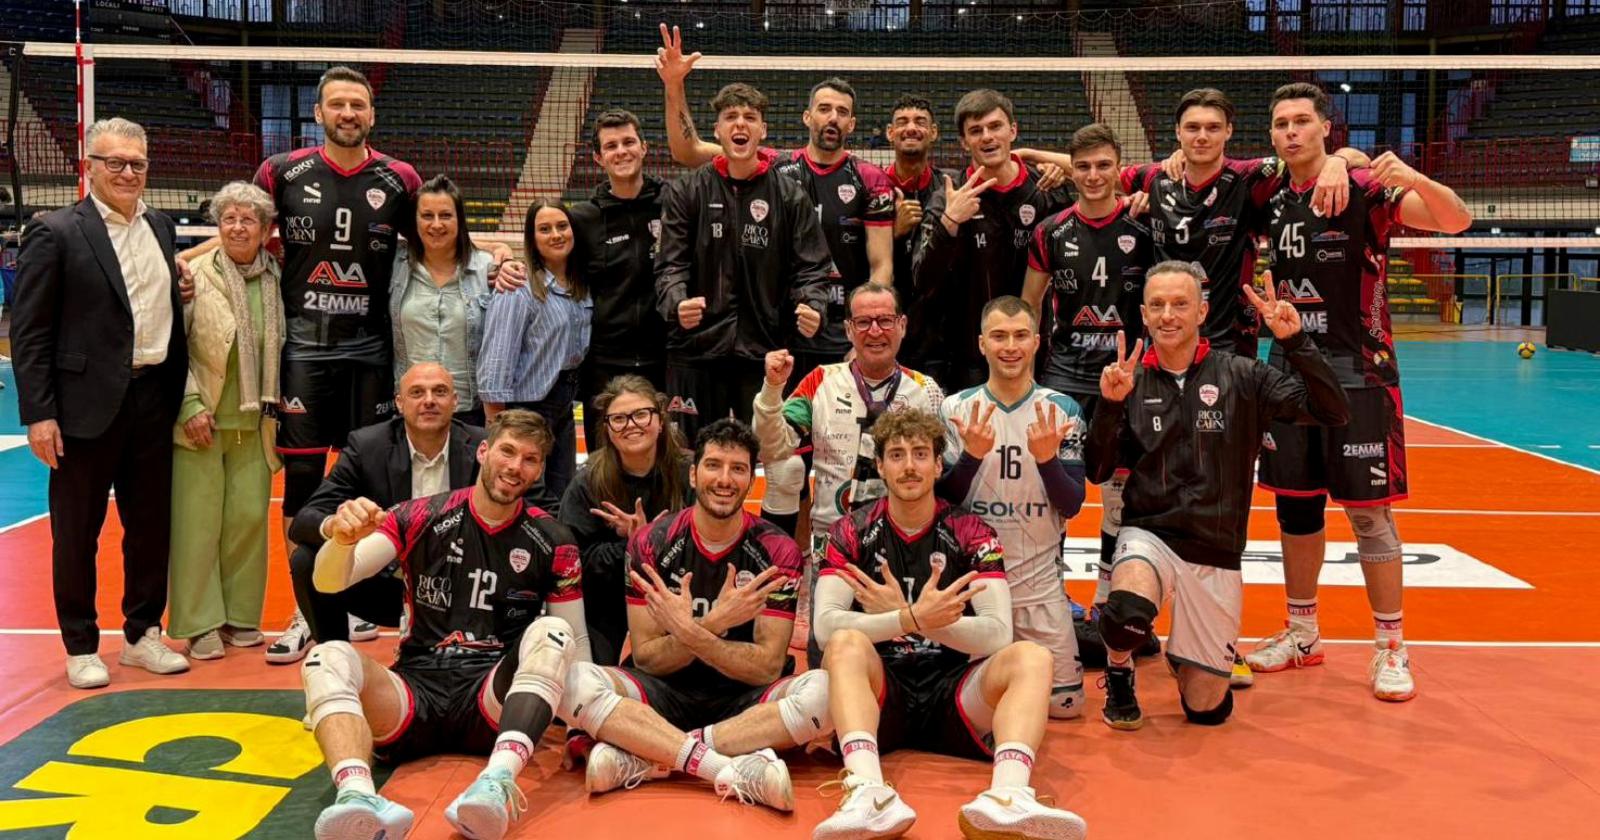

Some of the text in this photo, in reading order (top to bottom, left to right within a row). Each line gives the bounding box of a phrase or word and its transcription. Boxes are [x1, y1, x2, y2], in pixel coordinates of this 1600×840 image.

[334, 207, 352, 242] 9
[711, 223, 723, 238] 18
[1175, 217, 1192, 244] 5
[974, 233, 987, 249] 14
[1279, 222, 1306, 259] 45
[1092, 256, 1109, 288] 4
[303, 290, 370, 313] 2EMME
[1152, 416, 1163, 432] 8
[1198, 410, 1223, 420] RICO
[1343, 442, 1385, 458] 2EMME
[996, 445, 1022, 480] 16
[970, 501, 1048, 517] SOKIT
[468, 568, 498, 611] 12
